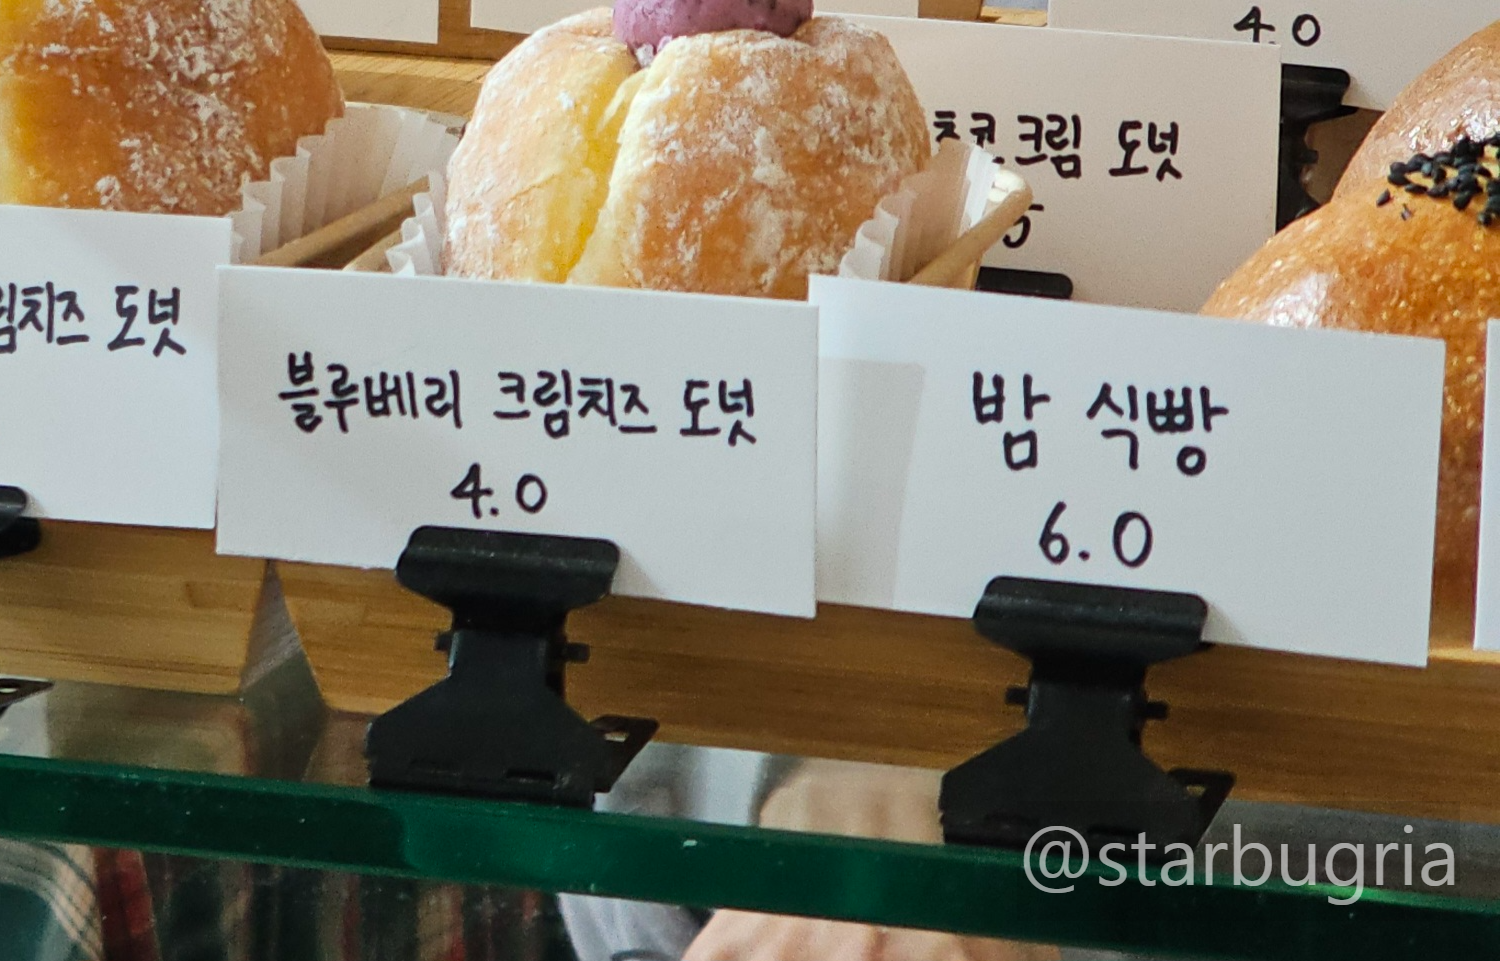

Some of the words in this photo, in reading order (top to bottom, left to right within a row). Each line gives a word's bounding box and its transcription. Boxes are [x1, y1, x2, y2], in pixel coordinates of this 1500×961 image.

[1014, 113, 1082, 180] 크림
[1108, 119, 1183, 183] 도넛
[106, 285, 187, 358] 도넛
[277, 350, 463, 434] 블루베리
[492, 368, 658, 440] 크림치즈
[679, 378, 757, 447] 도넛
[972, 370, 1052, 472] 밤
[1085, 382, 1230, 477] 식빵
[449, 462, 548, 520] 4.0
[1038, 501, 1153, 569] 6.0
